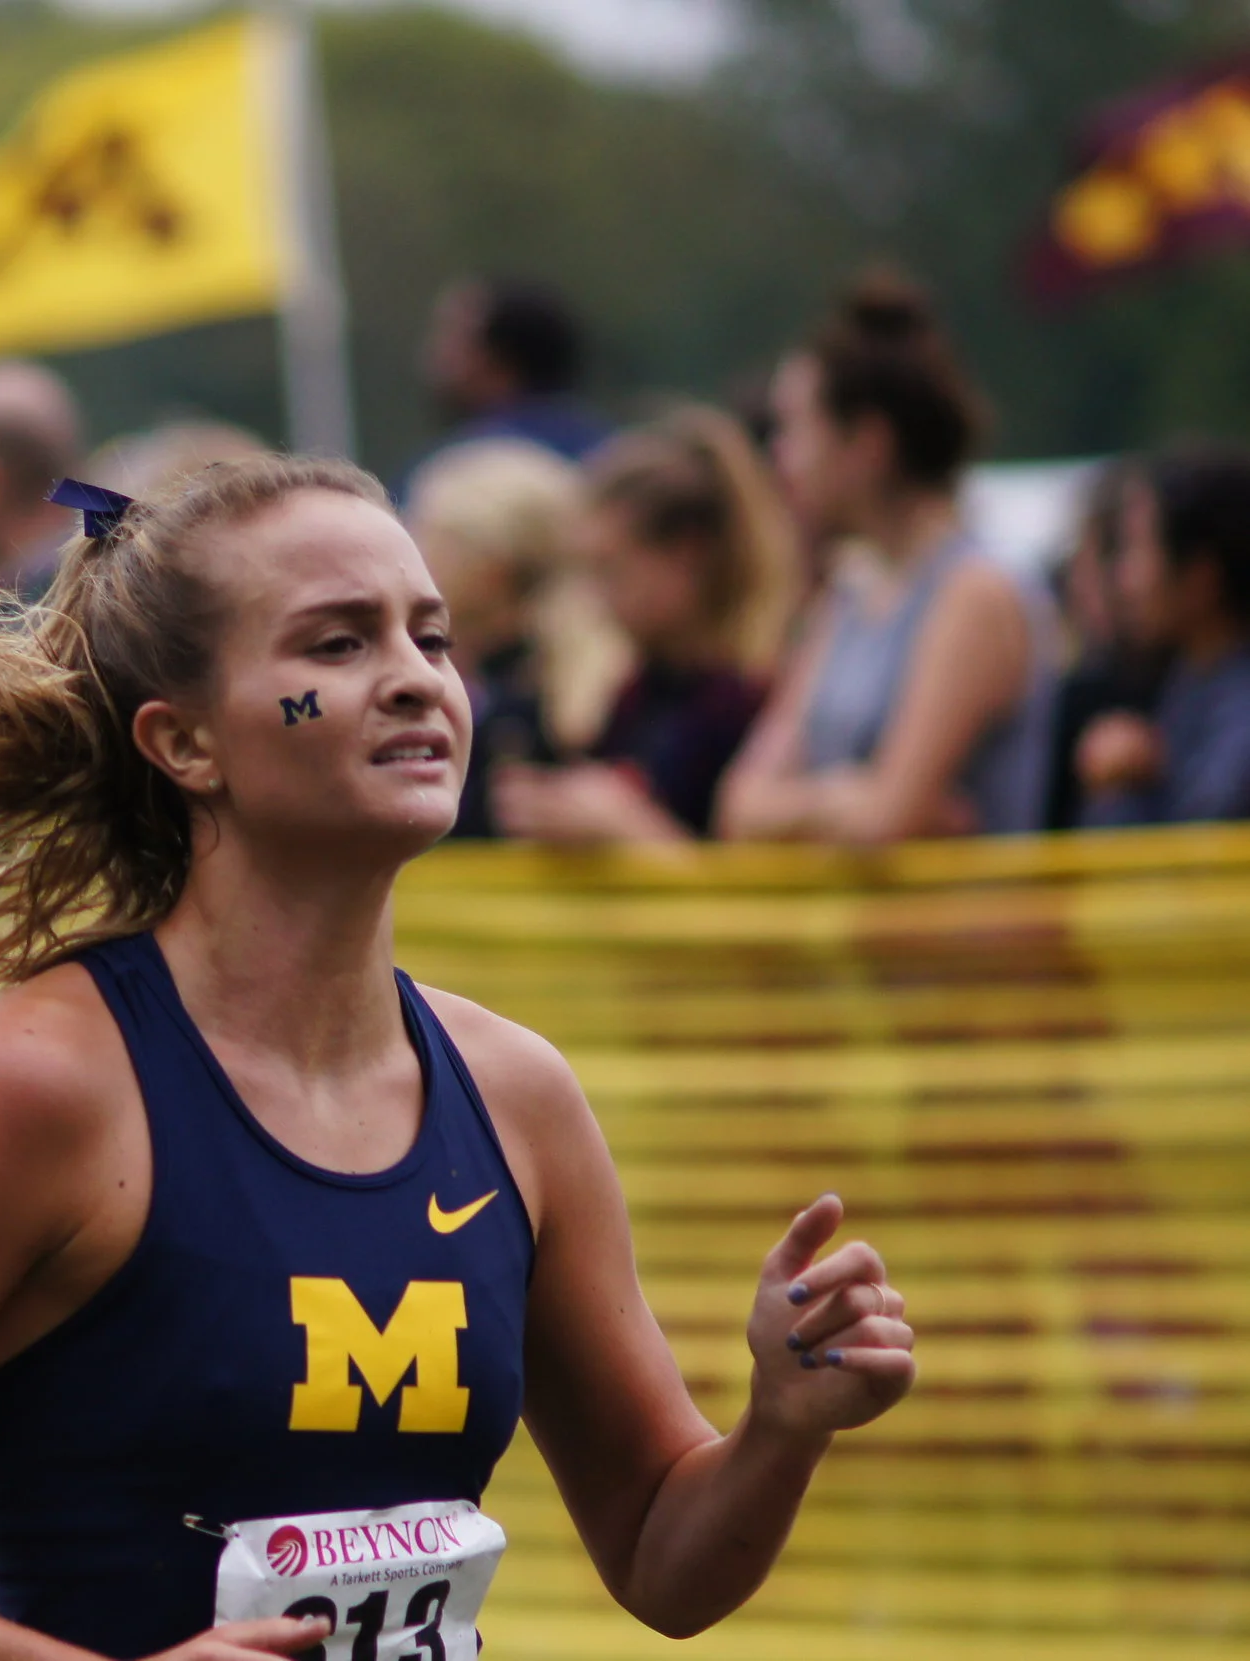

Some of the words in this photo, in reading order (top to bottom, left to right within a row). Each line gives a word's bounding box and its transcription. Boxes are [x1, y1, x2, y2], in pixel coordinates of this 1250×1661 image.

[279, 688, 323, 726] M
[288, 1276, 470, 1433] M
[330, 1575, 339, 1587] A
[341, 1570, 381, 1585] Tarkett
[384, 1566, 420, 1582] Sports
